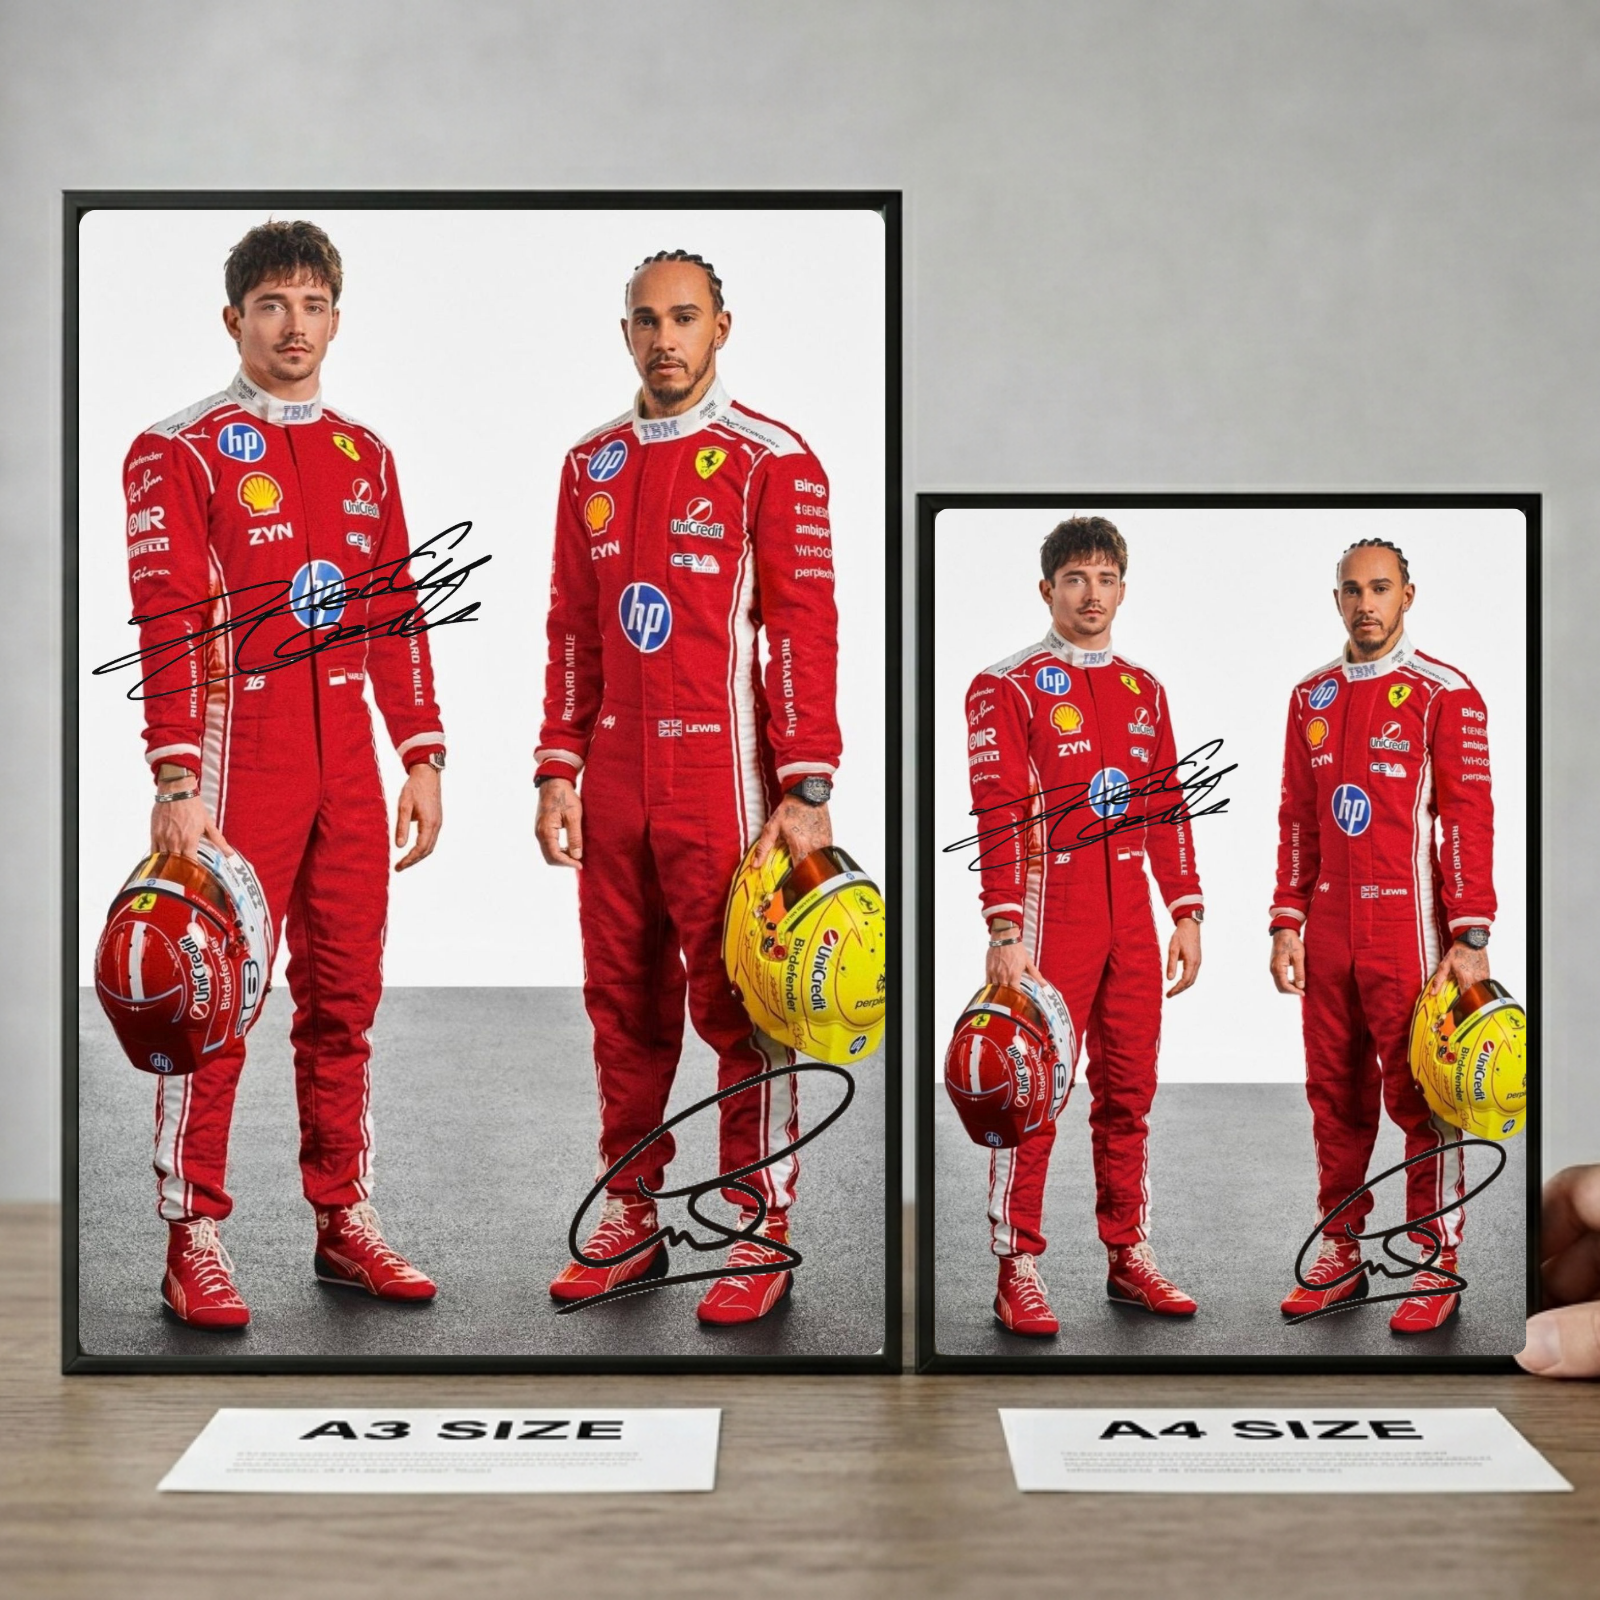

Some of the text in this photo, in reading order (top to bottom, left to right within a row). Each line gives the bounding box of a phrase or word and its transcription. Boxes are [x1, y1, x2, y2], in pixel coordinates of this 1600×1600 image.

[282, 403, 314, 420] IBM
[227, 424, 258, 460] hp
[641, 420, 680, 440] IBM
[739, 426, 780, 449] TECHNOLOGY
[590, 443, 625, 480] hp
[127, 468, 163, 505] Ray-Ban
[248, 522, 294, 546] ZYN
[671, 519, 724, 539] UniCredit
[591, 540, 621, 561] ZYN
[627, 583, 664, 652] hp
[1083, 652, 1106, 664] IBM
[1348, 664, 1377, 679] IBM
[189, 660, 198, 718] RICHARD
[243, 675, 266, 691] 16
[411, 668, 425, 706] MILLE
[561, 633, 576, 721] RICHARD MILLE
[781, 637, 799, 737] RICHARD MILLE
[1042, 667, 1065, 693] hp
[1311, 681, 1336, 708] hp
[968, 700, 995, 727] Ray-Ban
[685, 723, 721, 733] LEWIS
[1058, 740, 1092, 757] ZYN
[1371, 737, 1410, 752] UniCredit
[1338, 785, 1365, 835] hp
[1054, 853, 1071, 864] 16
[1178, 848, 1189, 875] MILLE
[1289, 849, 1300, 886] RICHARD
[1452, 825, 1465, 898] RICHARD MILLE
[234, 865, 263, 909] IBM
[209, 936, 232, 1011] Bitdefender
[785, 937, 806, 1012] Bitdefender
[810, 945, 832, 1011] UniCredit
[1048, 993, 1069, 1025] IBM
[152, 1056, 169, 1072] hp
[1029, 1046, 1046, 1101] Bitdefender
[1455, 1046, 1470, 1102] Bitdefender
[1473, 1052, 1489, 1101] UniCredit
[987, 1134, 999, 1146] hp
[300, 1421, 624, 1440] A3 SIZE
[1099, 1421, 1424, 1440] A4 SIZE
